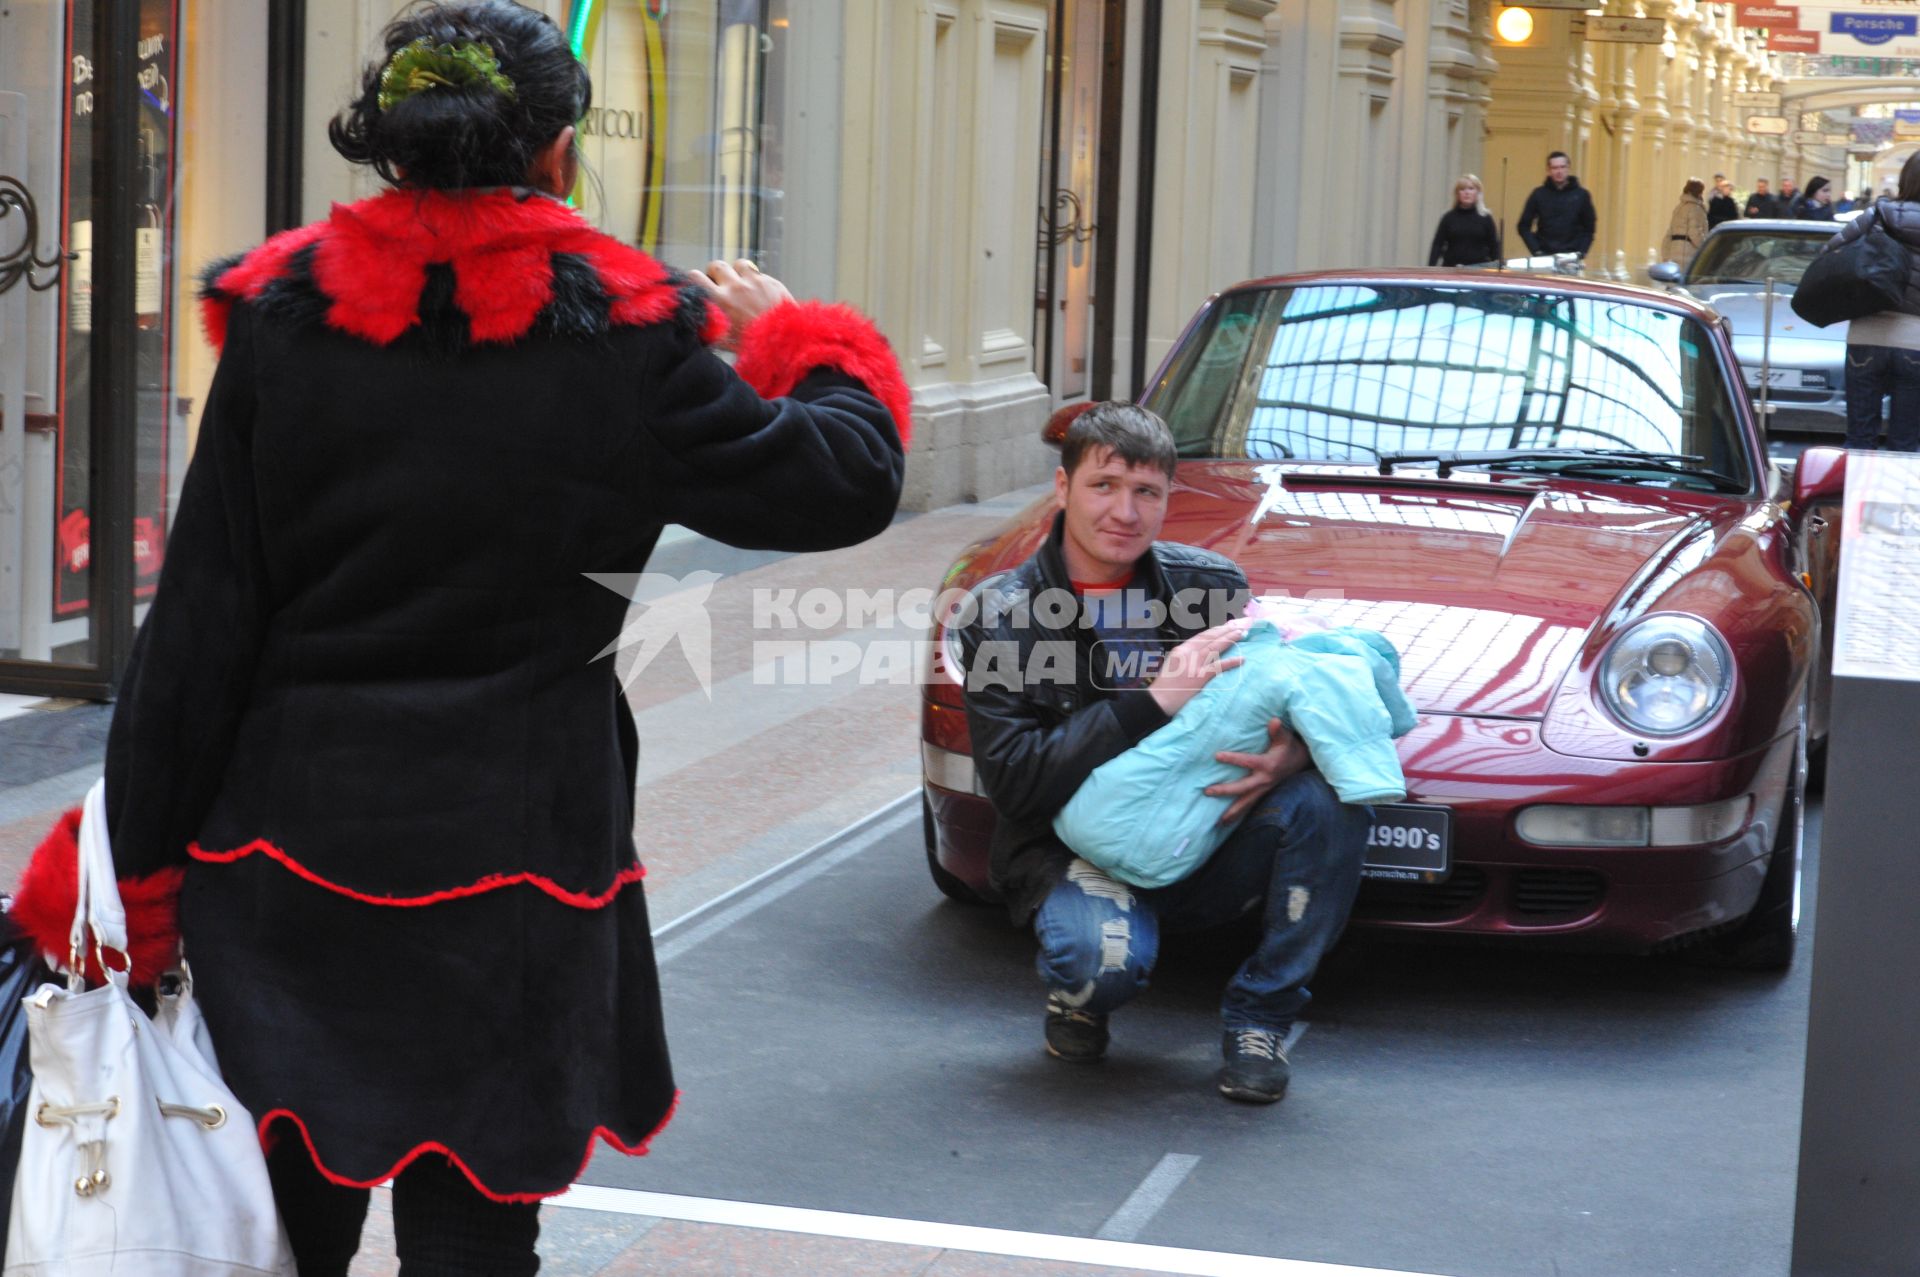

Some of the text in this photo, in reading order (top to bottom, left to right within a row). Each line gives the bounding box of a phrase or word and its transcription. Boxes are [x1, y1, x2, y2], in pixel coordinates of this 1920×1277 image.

[1844, 16, 1905, 31] Porsche
[584, 106, 643, 139] RTICOLI
[1361, 869, 1419, 880] .porsche.ru
